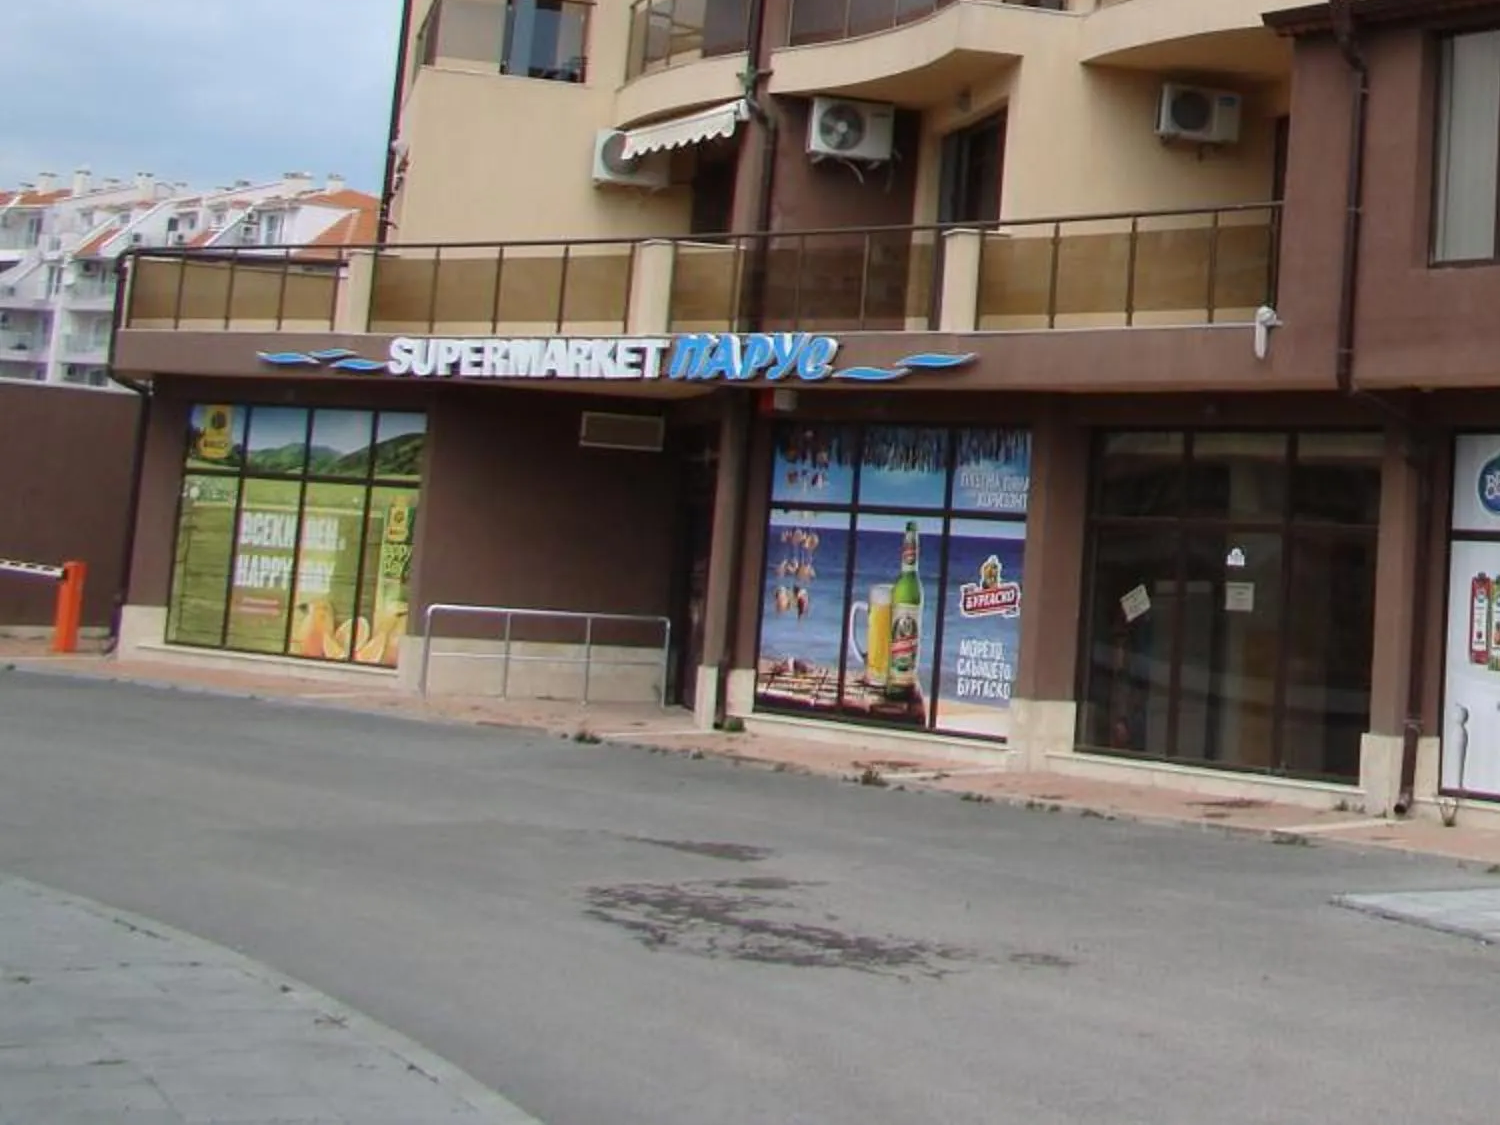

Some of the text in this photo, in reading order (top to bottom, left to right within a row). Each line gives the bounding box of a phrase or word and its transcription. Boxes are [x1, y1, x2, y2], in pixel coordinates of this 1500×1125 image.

[388, 336, 668, 378] SUPERMARKET
[233, 554, 293, 591] HAPPY
[957, 677, 1012, 700] БУРГАСКО
